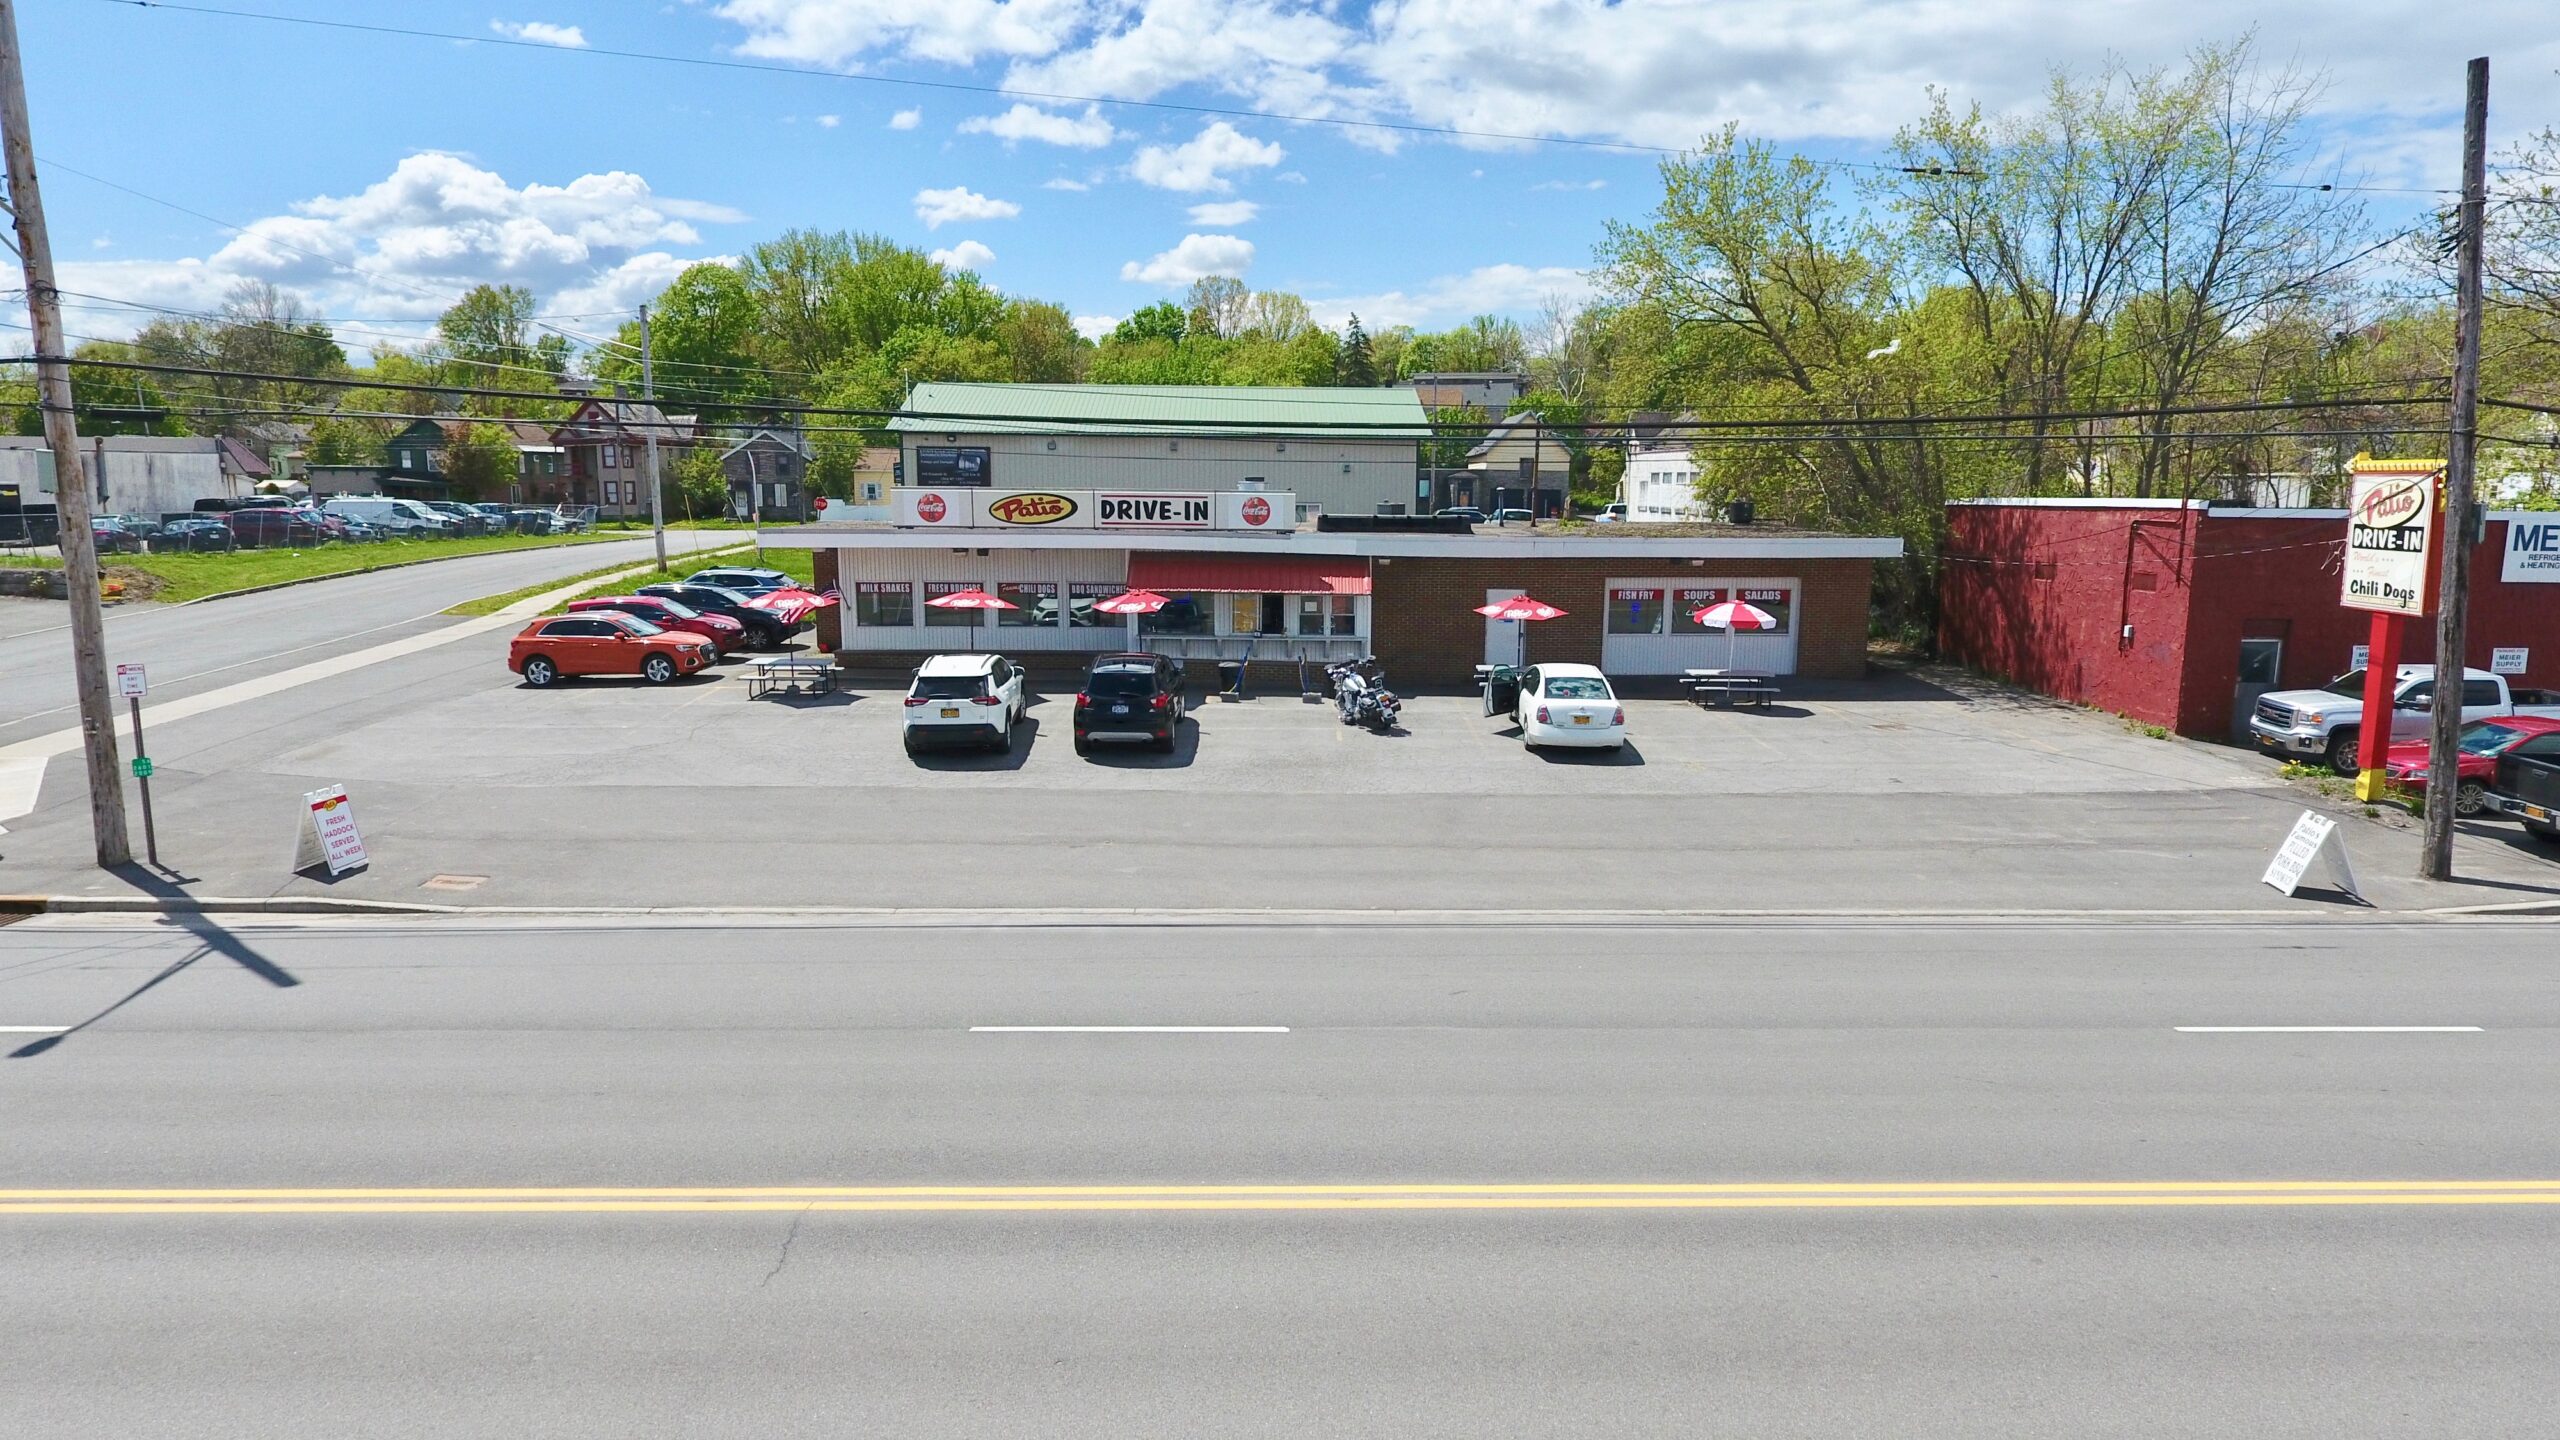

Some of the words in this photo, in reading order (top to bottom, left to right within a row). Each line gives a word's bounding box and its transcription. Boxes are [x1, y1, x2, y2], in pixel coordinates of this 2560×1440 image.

[992, 497, 1065, 521] Patio
[2360, 484, 2415, 525] Patio
[1101, 500, 1208, 521] DRIVE-IN
[2353, 528, 2422, 551] DRIVE-IN
[860, 583, 879, 593] MILK
[880, 583, 910, 593] SHAKES
[928, 583, 949, 593] FRESH
[1020, 583, 1037, 594] CHILI
[1037, 584, 1056, 594] DOGS
[1071, 584, 1085, 595] BBQ
[1618, 590, 1638, 600] FISH
[1639, 590, 1655, 600] FRY
[1683, 590, 1716, 600] SOUPS
[1744, 590, 1781, 600] SALADS
[2350, 579, 2378, 596] Chili
[2383, 582, 2415, 609] Dogs
[325, 815, 346, 826] FRESH
[324, 824, 354, 839] HADDOCK
[331, 836, 355, 848] SERVED
[344, 845, 363, 856] WEEK
